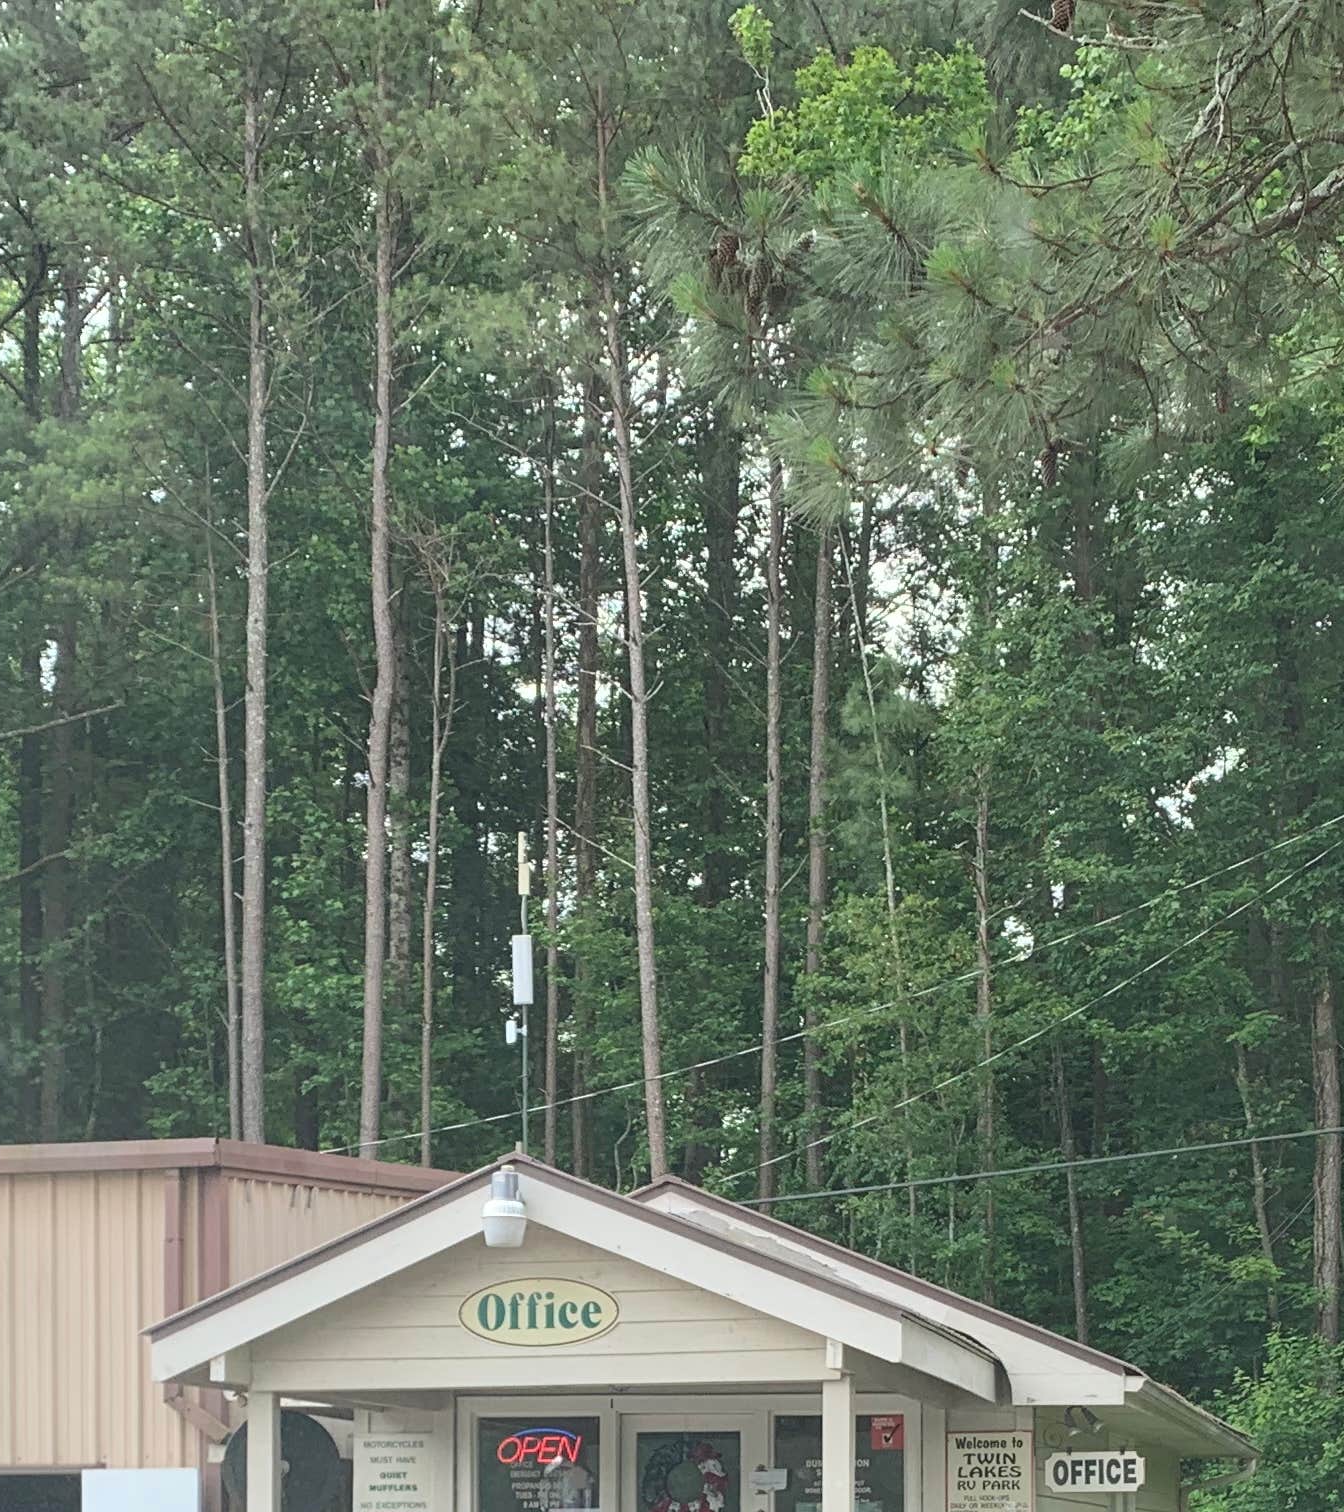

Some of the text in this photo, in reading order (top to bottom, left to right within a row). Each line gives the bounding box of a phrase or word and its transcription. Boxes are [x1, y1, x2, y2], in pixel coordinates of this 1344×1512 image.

[477, 1292, 602, 1331] Office
[363, 1441, 424, 1449] MOTORCYCLES
[955, 1436, 1023, 1449] Welcome to
[497, 1435, 582, 1464] OPEN
[369, 1456, 416, 1464] MUST HAVE
[962, 1453, 1016, 1464] TWIN
[379, 1472, 407, 1480] QUIET
[958, 1466, 1022, 1478] LAKES
[1052, 1458, 1137, 1486] OFFICE
[369, 1484, 418, 1492] MUFFLERS
[957, 1480, 1021, 1490] RV PARK
